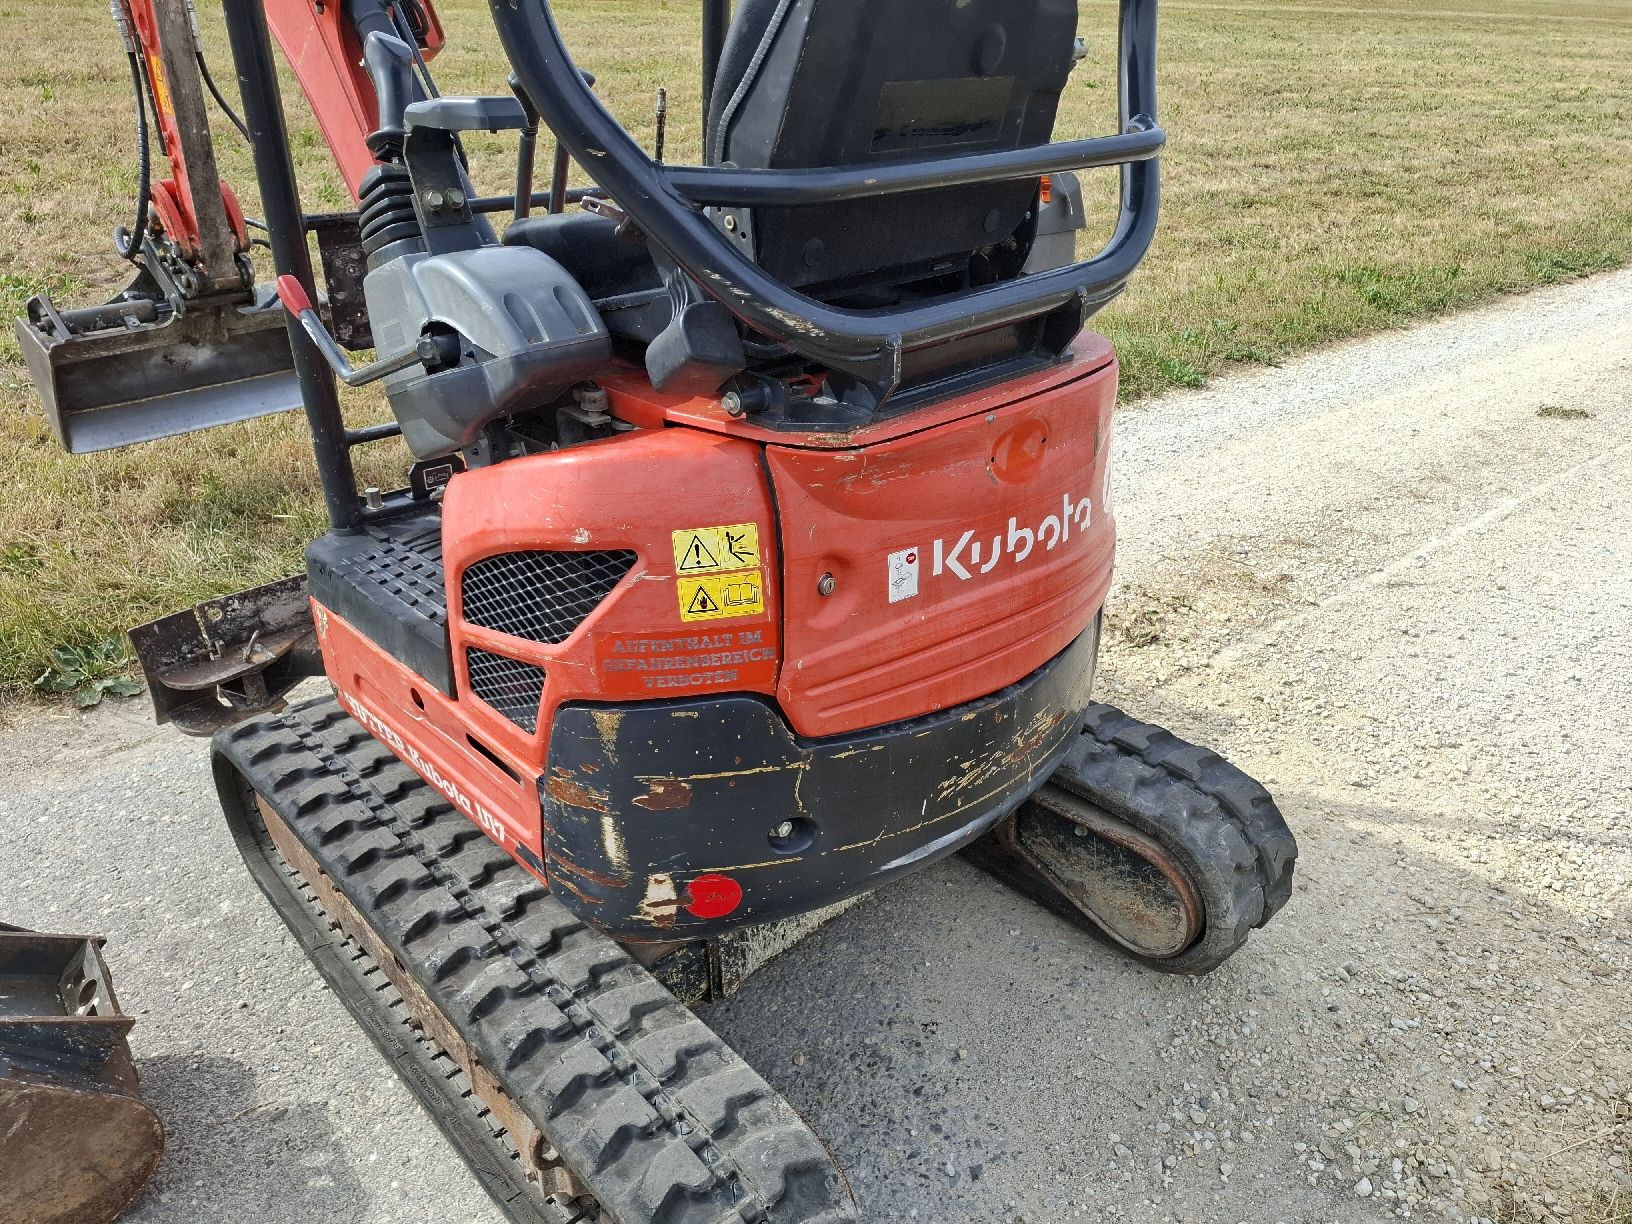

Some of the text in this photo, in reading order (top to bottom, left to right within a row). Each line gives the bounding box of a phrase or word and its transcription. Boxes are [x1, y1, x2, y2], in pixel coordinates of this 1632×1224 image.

[932, 493, 1092, 580] Kubota
[613, 630, 763, 653] AUFENTHALT IM
[641, 669, 739, 688] VERBOTEN
[406, 742, 473, 815] Kubota
